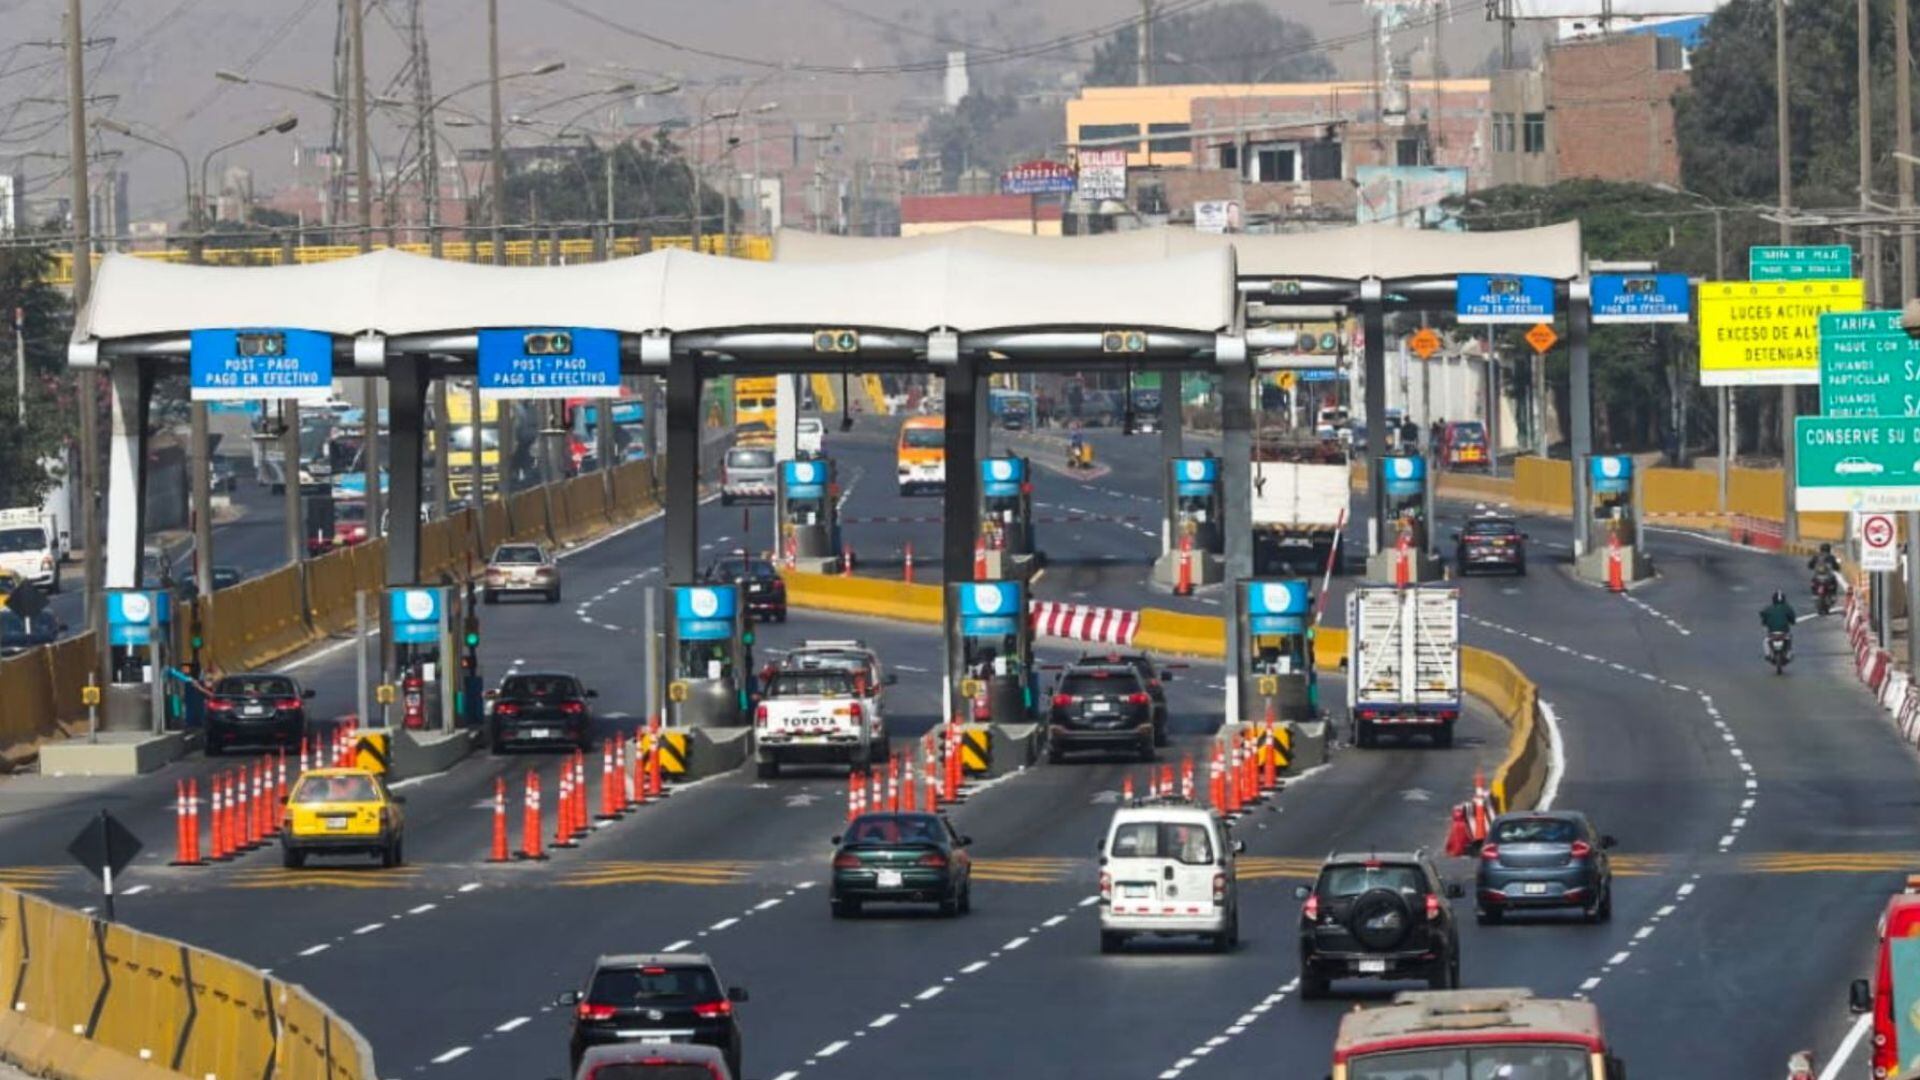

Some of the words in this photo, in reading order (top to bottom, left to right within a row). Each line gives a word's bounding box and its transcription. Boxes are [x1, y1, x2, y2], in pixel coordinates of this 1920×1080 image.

[1731, 305, 1772, 320] LUCES
[1834, 317, 1876, 332] TARIFA
[1717, 326, 1768, 341] EXCESO
[1773, 326, 1788, 340] DE
[1876, 341, 1898, 351] CON
[225, 358, 254, 371] POST
[267, 358, 299, 371] PAGO
[513, 358, 542, 371] POST
[555, 358, 586, 370] PAGO
[206, 372, 238, 385] PAGO
[243, 372, 258, 385] EN
[263, 371, 318, 385] EFECTIVO
[493, 372, 524, 385] PAGO
[531, 372, 546, 384] EN
[550, 371, 606, 384] EFECTIVO
[1829, 373, 1890, 385] PARTICULAR
[1806, 428, 1880, 445] CONSERVE
[1888, 428, 1905, 444] SU
[783, 717, 837, 727] TOYOTA
